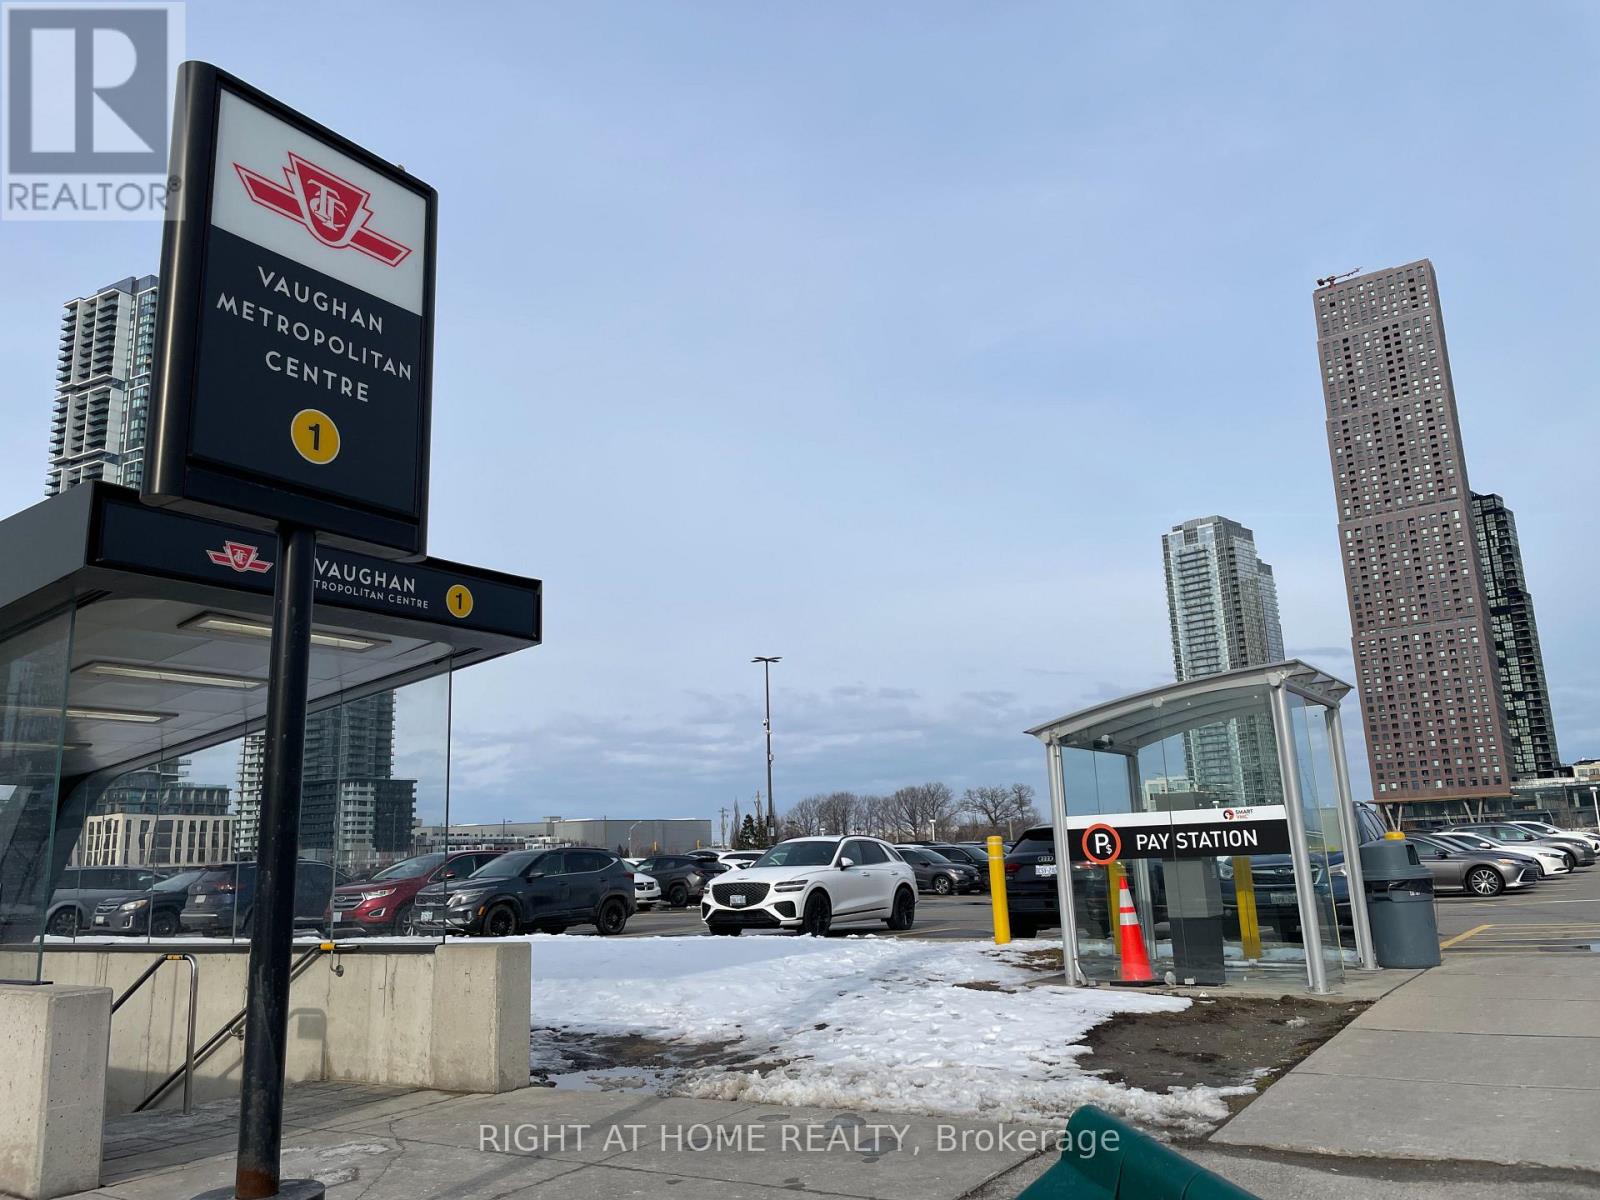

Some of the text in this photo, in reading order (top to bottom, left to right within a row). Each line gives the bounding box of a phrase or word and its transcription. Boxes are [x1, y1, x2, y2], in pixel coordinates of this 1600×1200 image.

[257, 265, 383, 335] VAUGHAN
[216, 292, 411, 381] METROPOLITAN
[265, 351, 369, 402] CENTRE
[308, 423, 320, 451] 1
[314, 558, 416, 594] VAUGHAN
[313, 579, 429, 609] TROPOLITAN CENTRE
[456, 592, 463, 610] 1
[1136, 829, 1258, 850] PAY STATION
